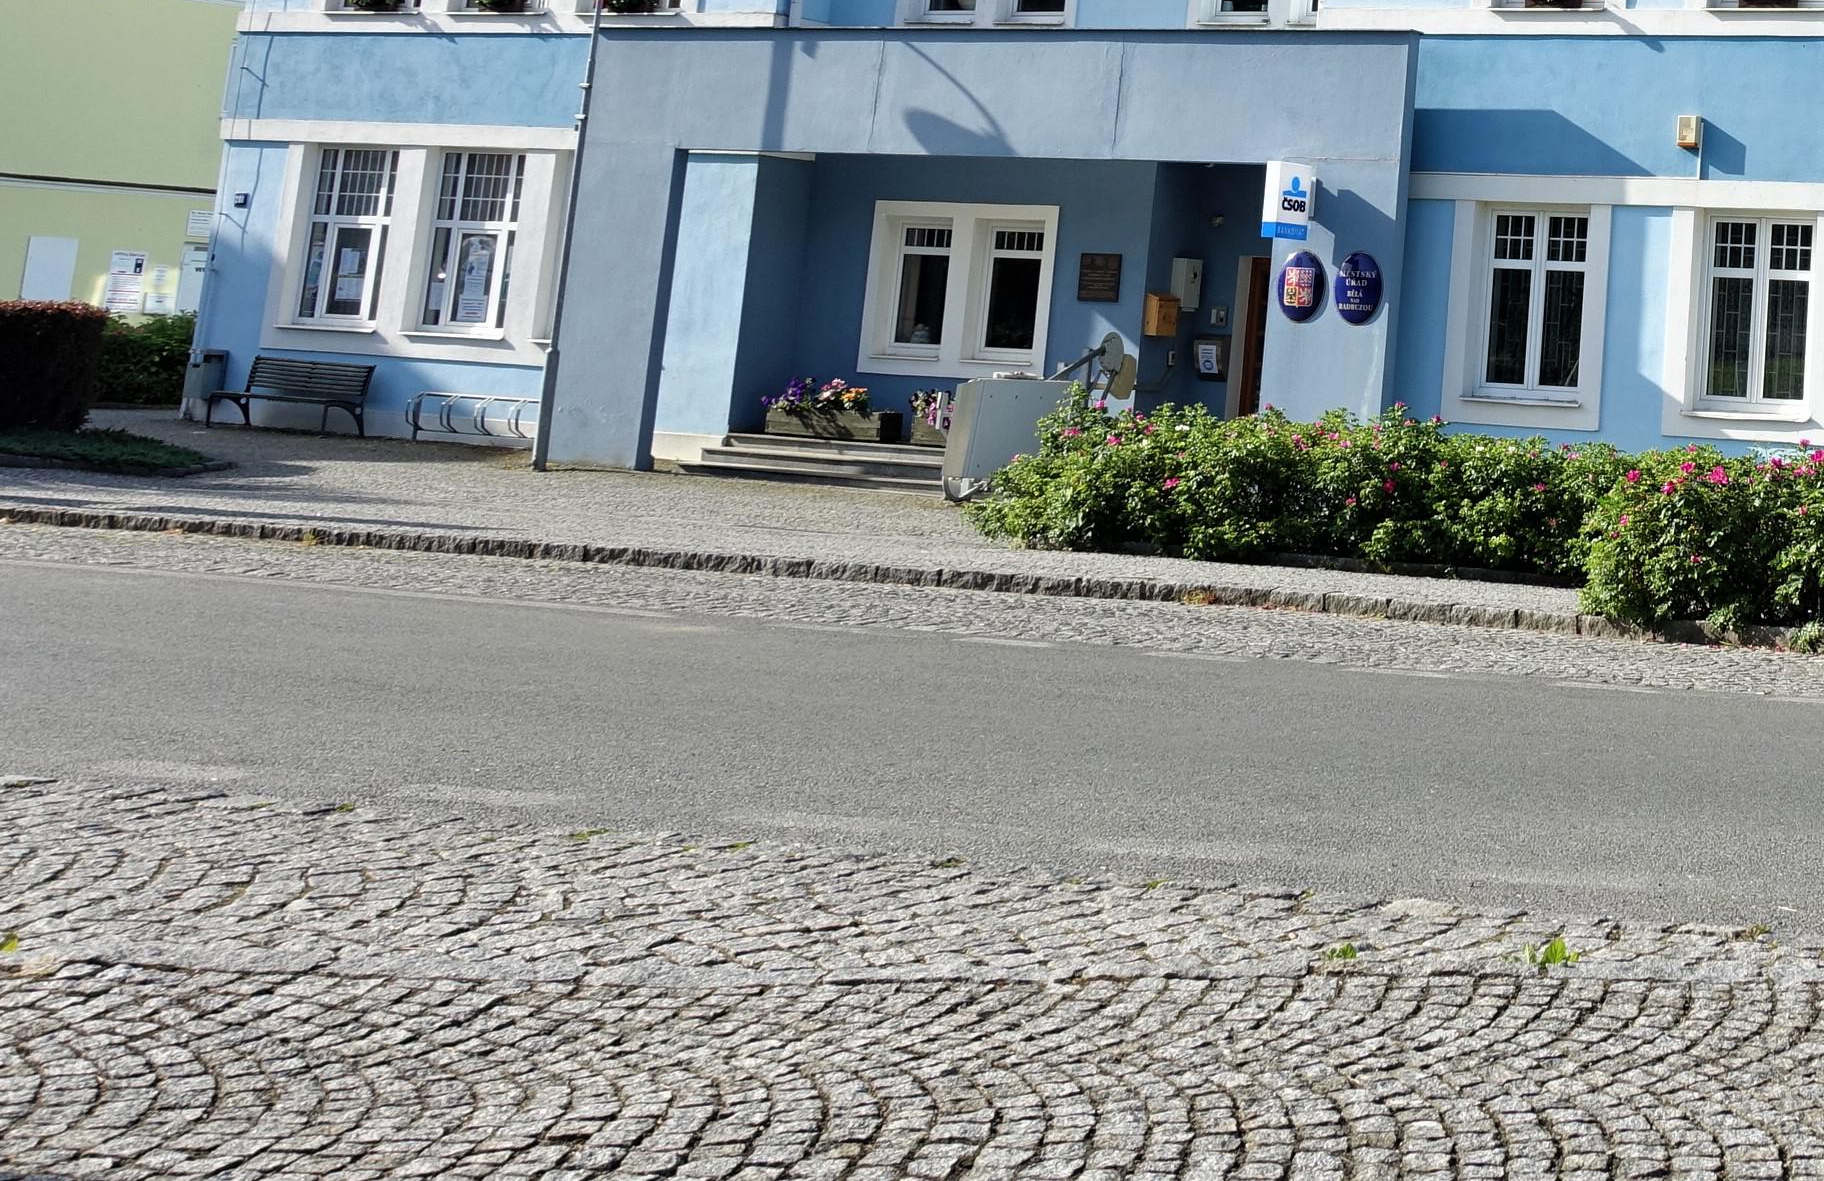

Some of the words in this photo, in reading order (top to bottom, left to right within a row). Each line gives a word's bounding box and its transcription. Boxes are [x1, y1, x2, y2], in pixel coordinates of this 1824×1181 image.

[1282, 196, 1306, 213] ČSOB
[1345, 278, 1368, 286] ÚŘAD
[1346, 289, 1363, 298] BĚLÁ
